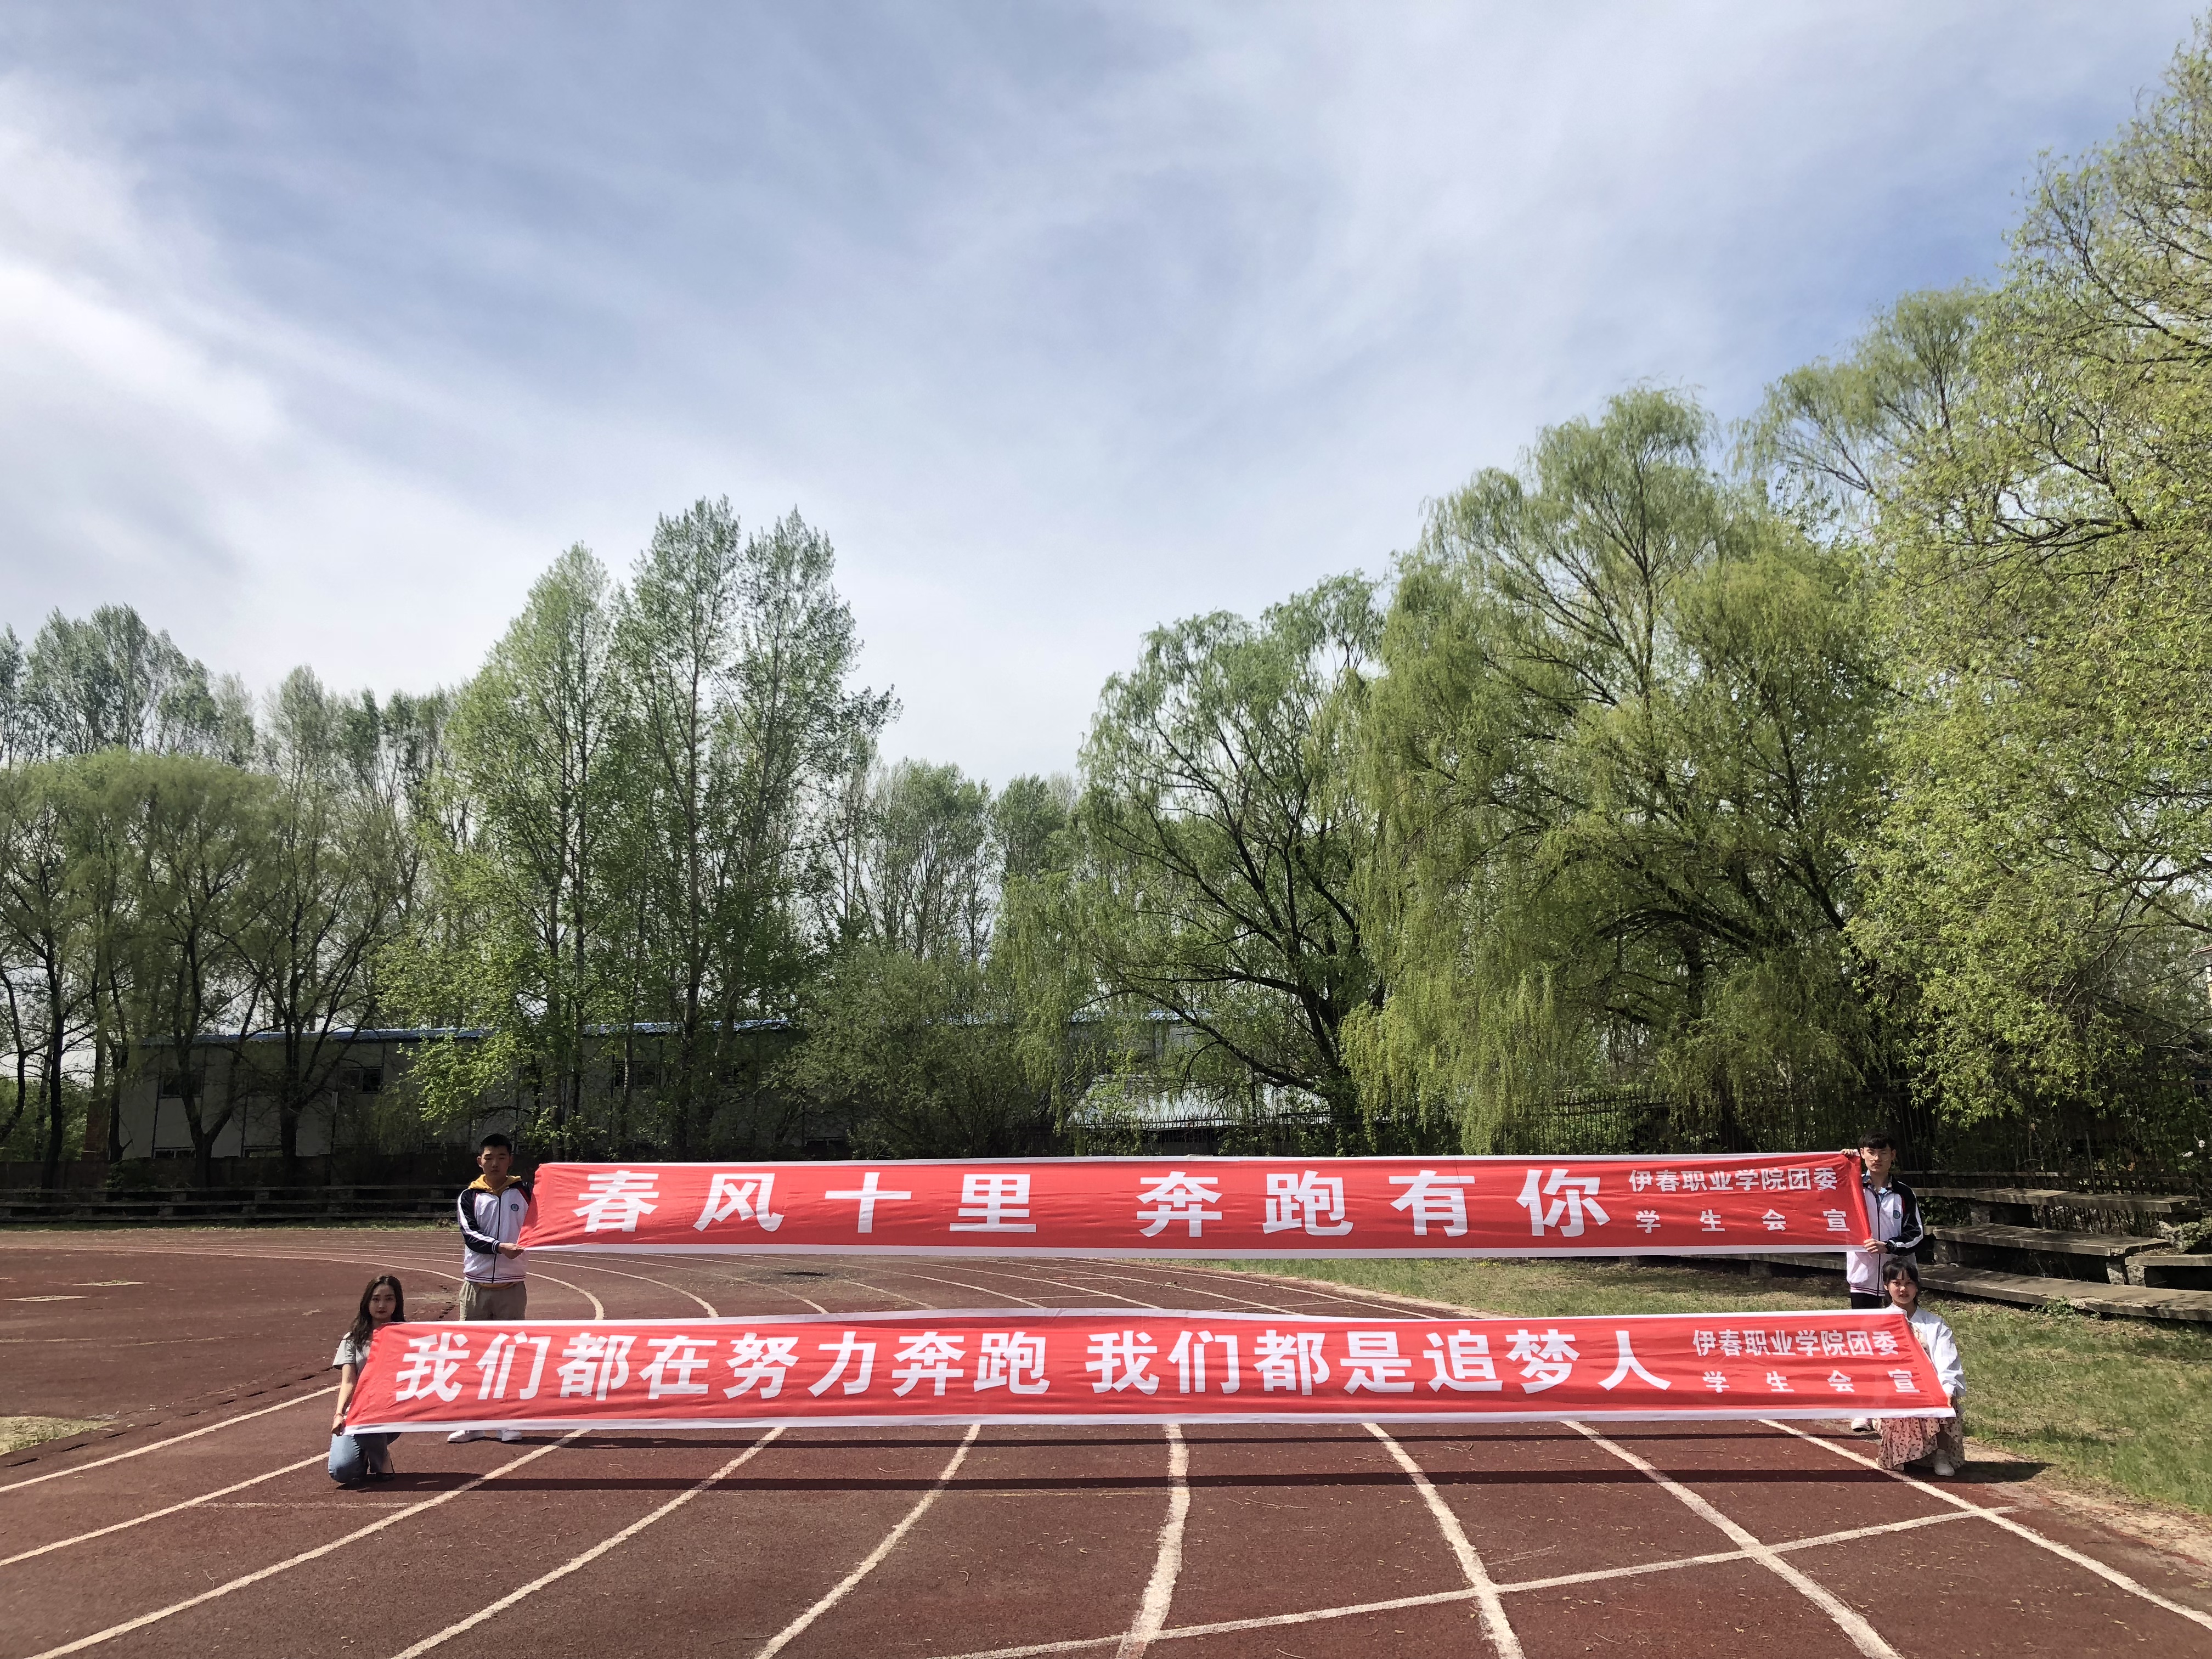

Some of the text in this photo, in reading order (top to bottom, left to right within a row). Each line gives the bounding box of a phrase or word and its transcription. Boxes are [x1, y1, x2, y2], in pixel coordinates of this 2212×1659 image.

[1628, 1167, 1838, 1193] 伊春职业学院团委
[572, 1168, 1611, 1238] 春风十里 奔跑有你
[1635, 1208, 1850, 1233] 学生会宣
[1692, 1328, 1899, 1357] 伊春职业学院团委
[396, 1329, 1672, 1402] 我们都在努力奔跑 我们都是追梦人
[1702, 1369, 1920, 1393] 学生会宣
